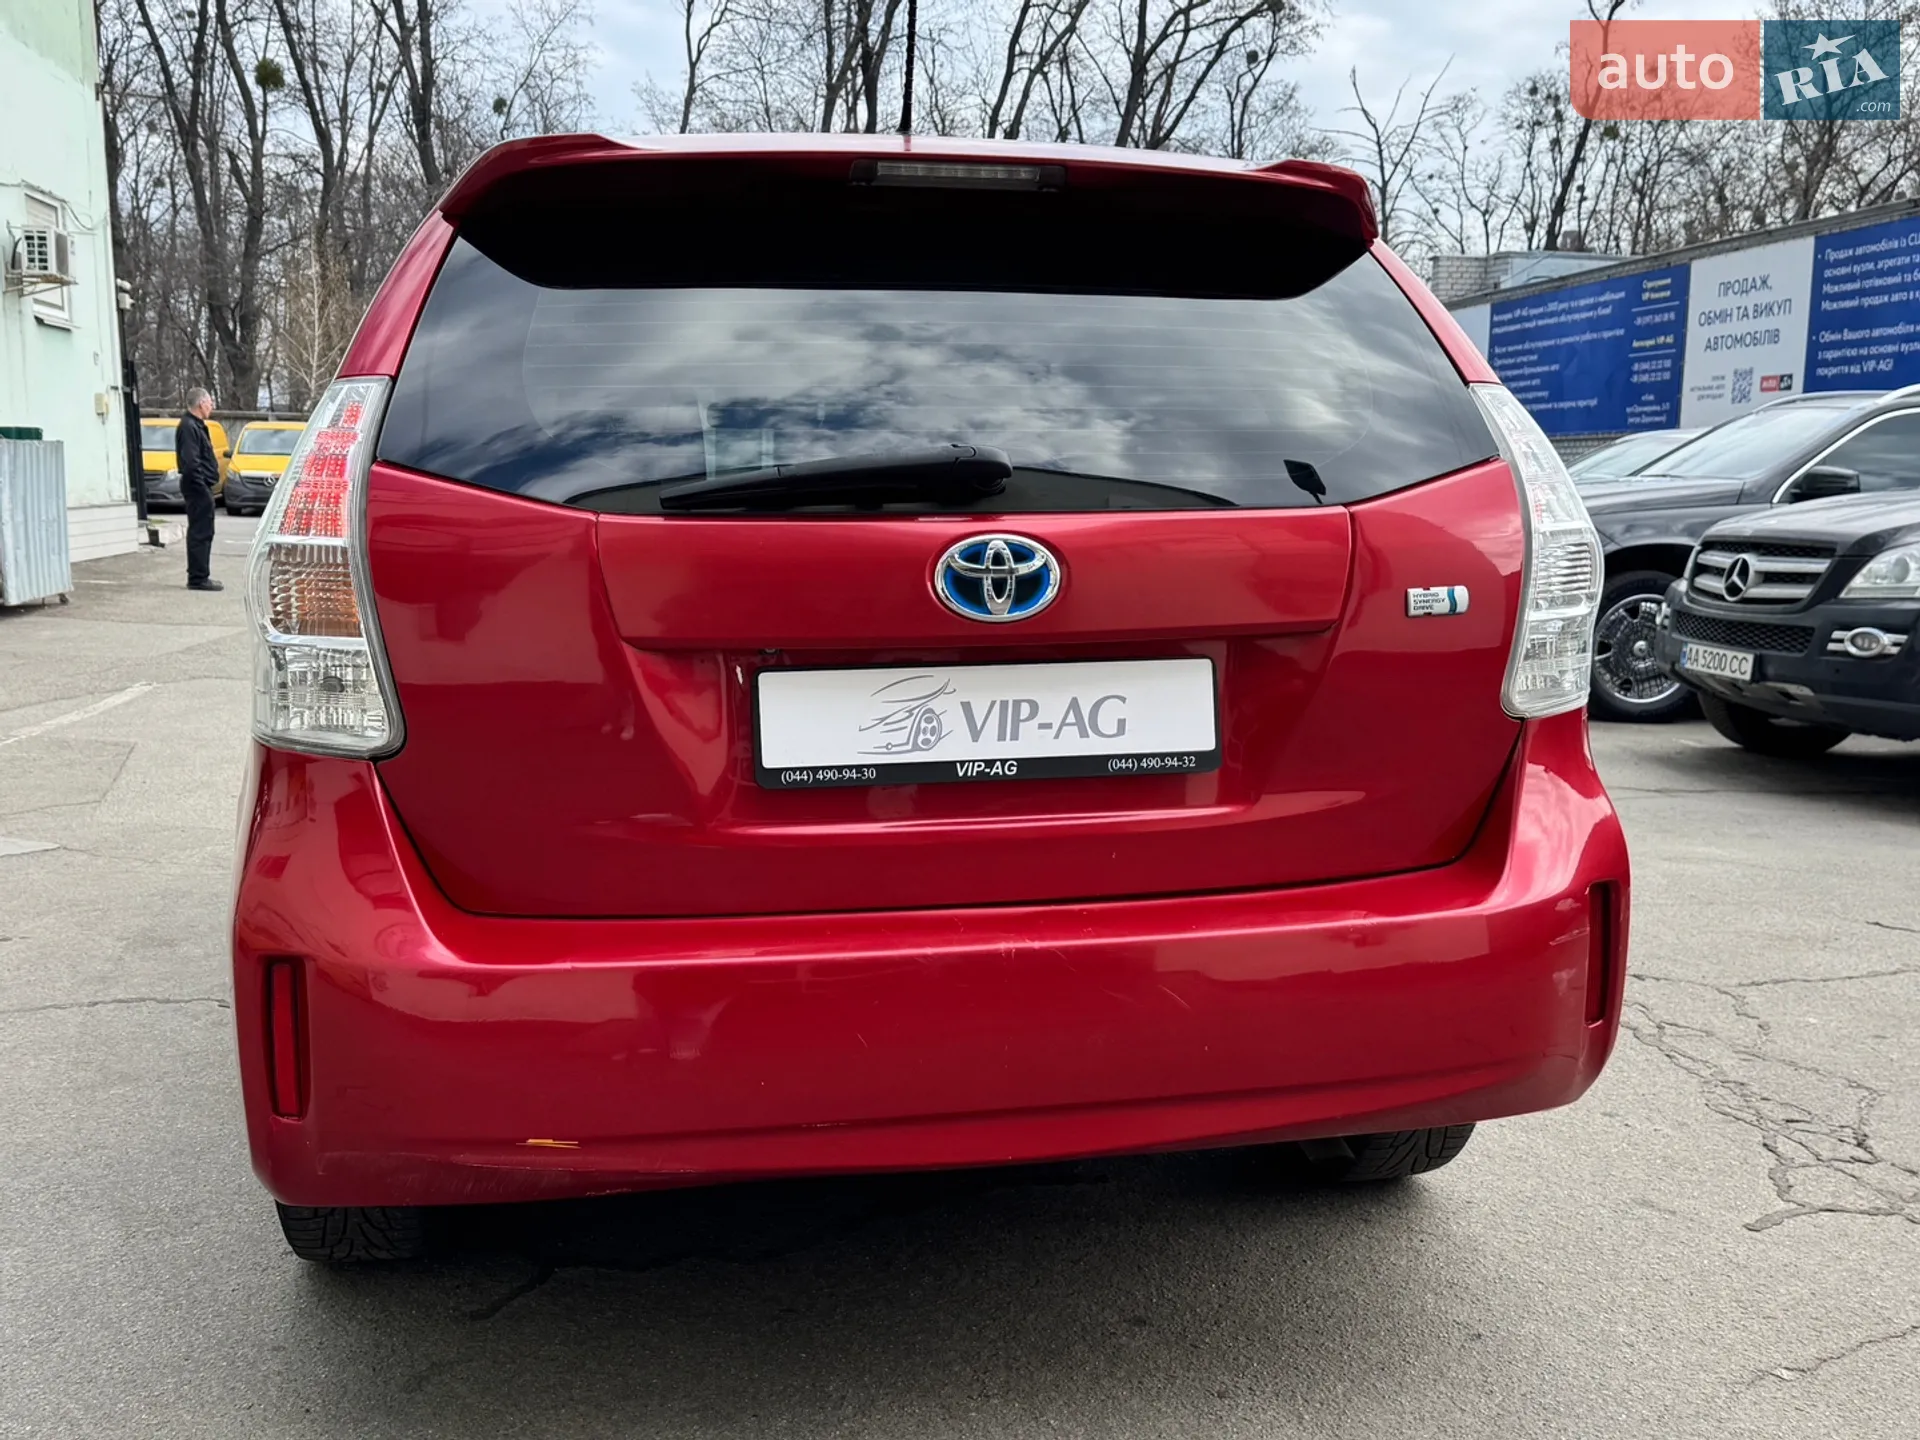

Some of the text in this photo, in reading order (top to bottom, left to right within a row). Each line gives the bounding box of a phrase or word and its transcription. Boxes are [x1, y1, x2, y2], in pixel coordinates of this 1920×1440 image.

[1717, 274, 1772, 298] ПРОДАЖ,
[1698, 307, 1733, 327] ОБМІН
[1735, 305, 1750, 322] ТА
[1752, 298, 1792, 320] ВИКУП
[1703, 328, 1780, 353] АВТОМОБІЛІВ
[1687, 646, 1748, 675] AA 5200 CC
[960, 695, 1127, 743] VIP-AG
[956, 760, 1018, 777] VIP-AG
[1108, 755, 1196, 772] (044) 490-94-32
[781, 767, 877, 785] (044) 490-94-30
